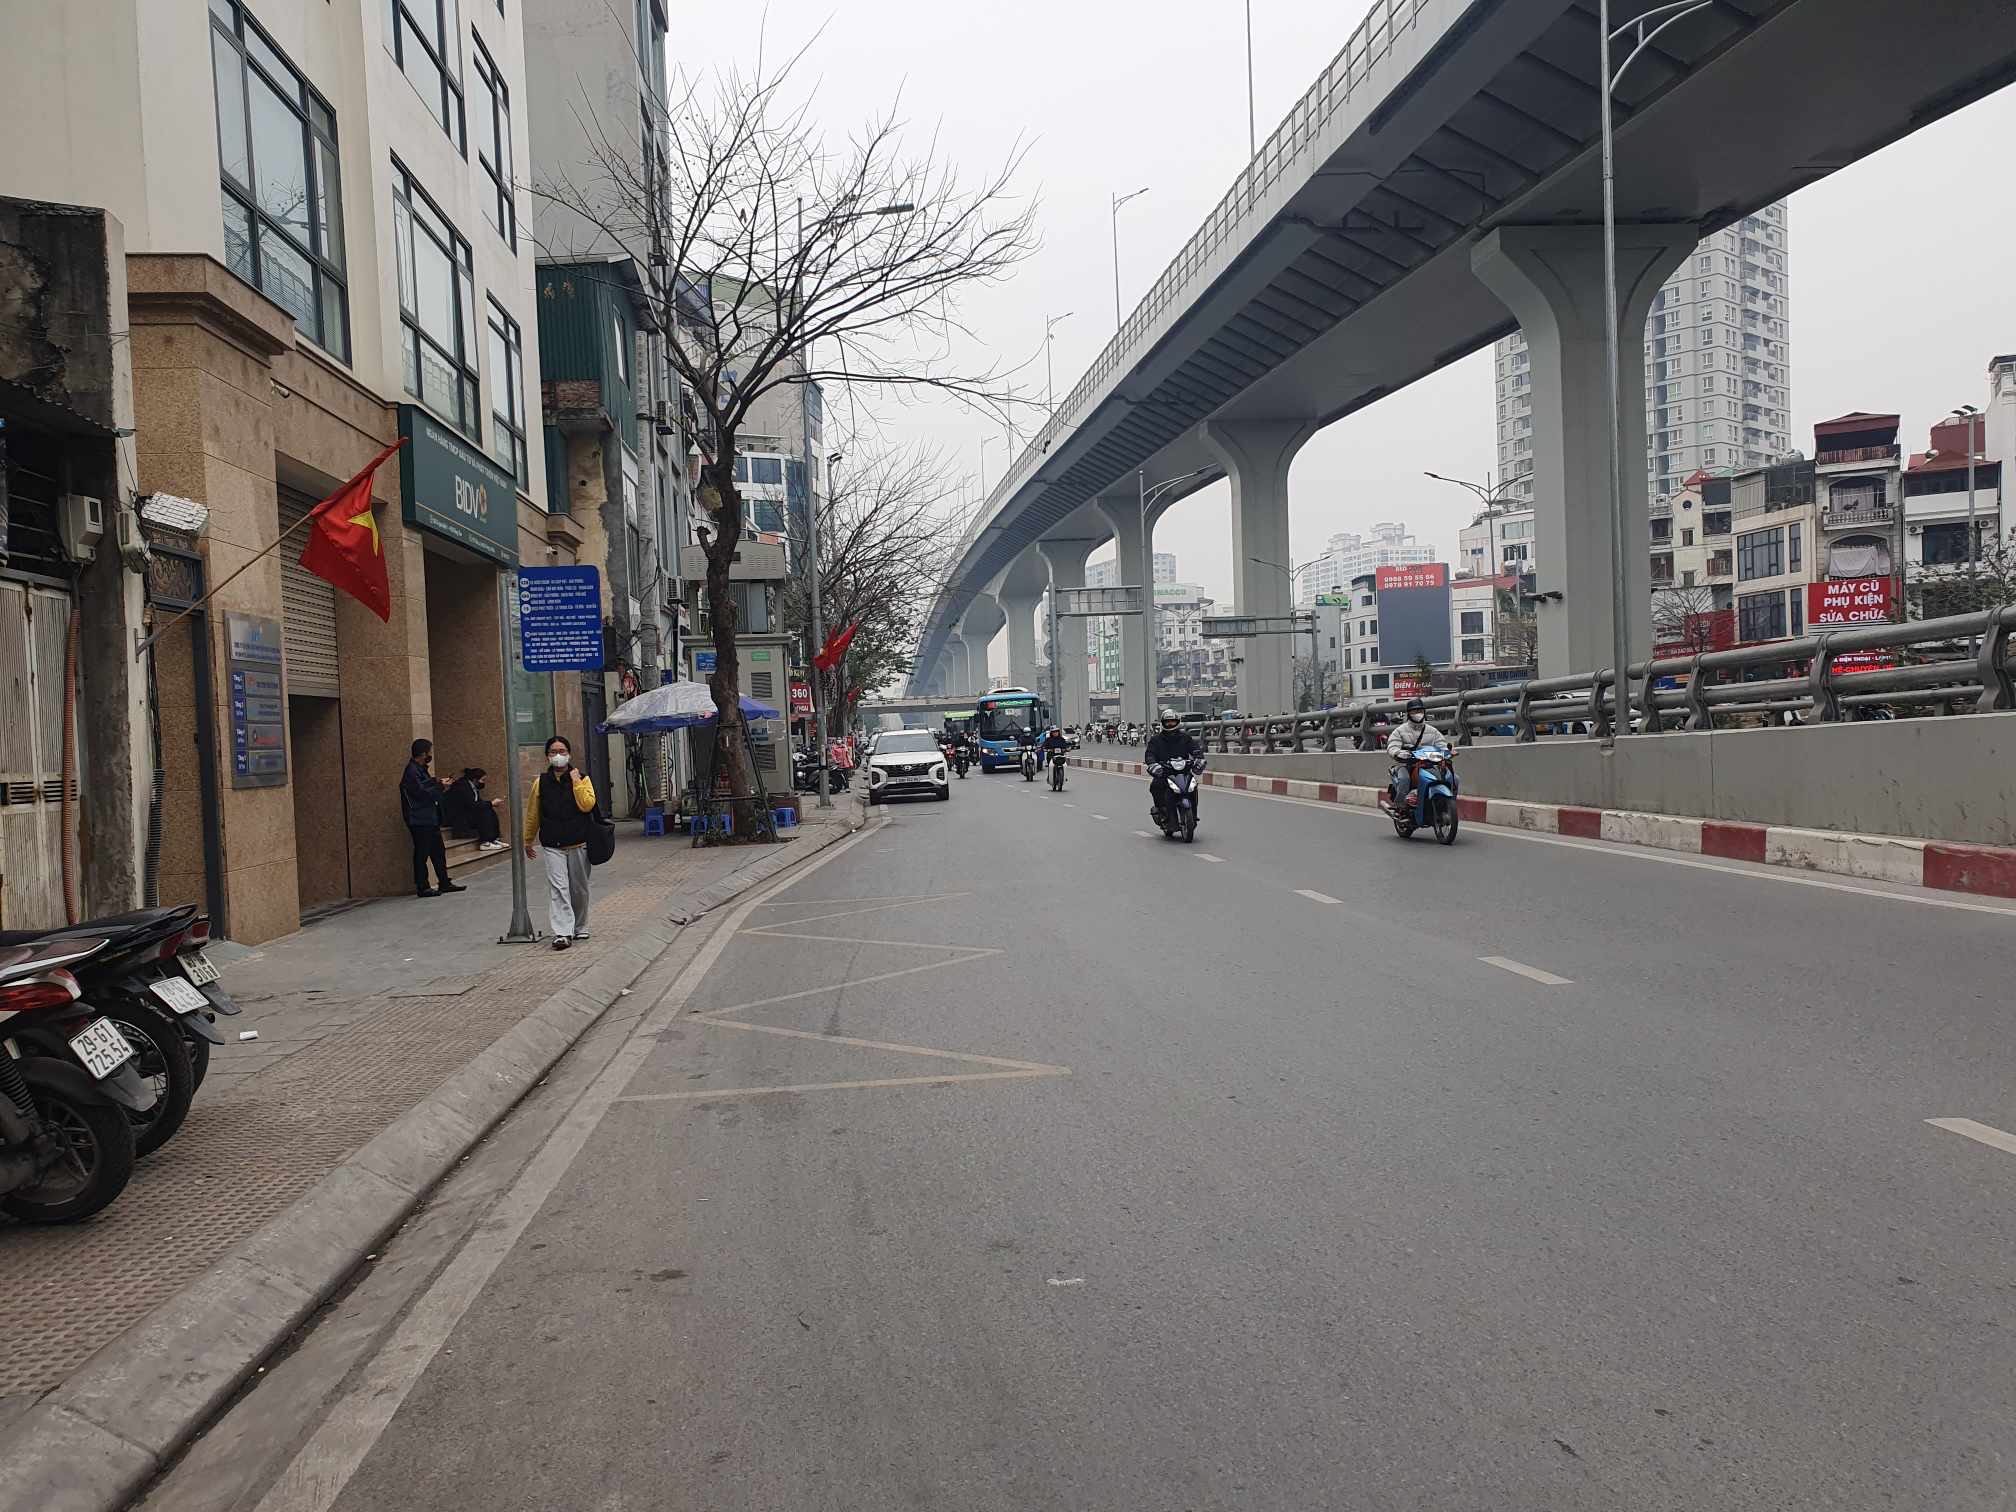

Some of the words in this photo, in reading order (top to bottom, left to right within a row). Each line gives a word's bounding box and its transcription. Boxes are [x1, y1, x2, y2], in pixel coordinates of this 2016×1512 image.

[455, 474, 479, 519] BIDV
[1828, 581, 1857, 595] MÁY
[1859, 579, 1880, 592] CŨ
[1823, 596, 1850, 609] PHỤ
[1854, 592, 1884, 607] KIỆN
[1819, 609, 1845, 623] SỬA
[1848, 608, 1887, 621] CHỮA
[791, 688, 808, 699] 360
[77, 1023, 114, 1056] 29-G1
[87, 1038, 130, 1076] 725.54
